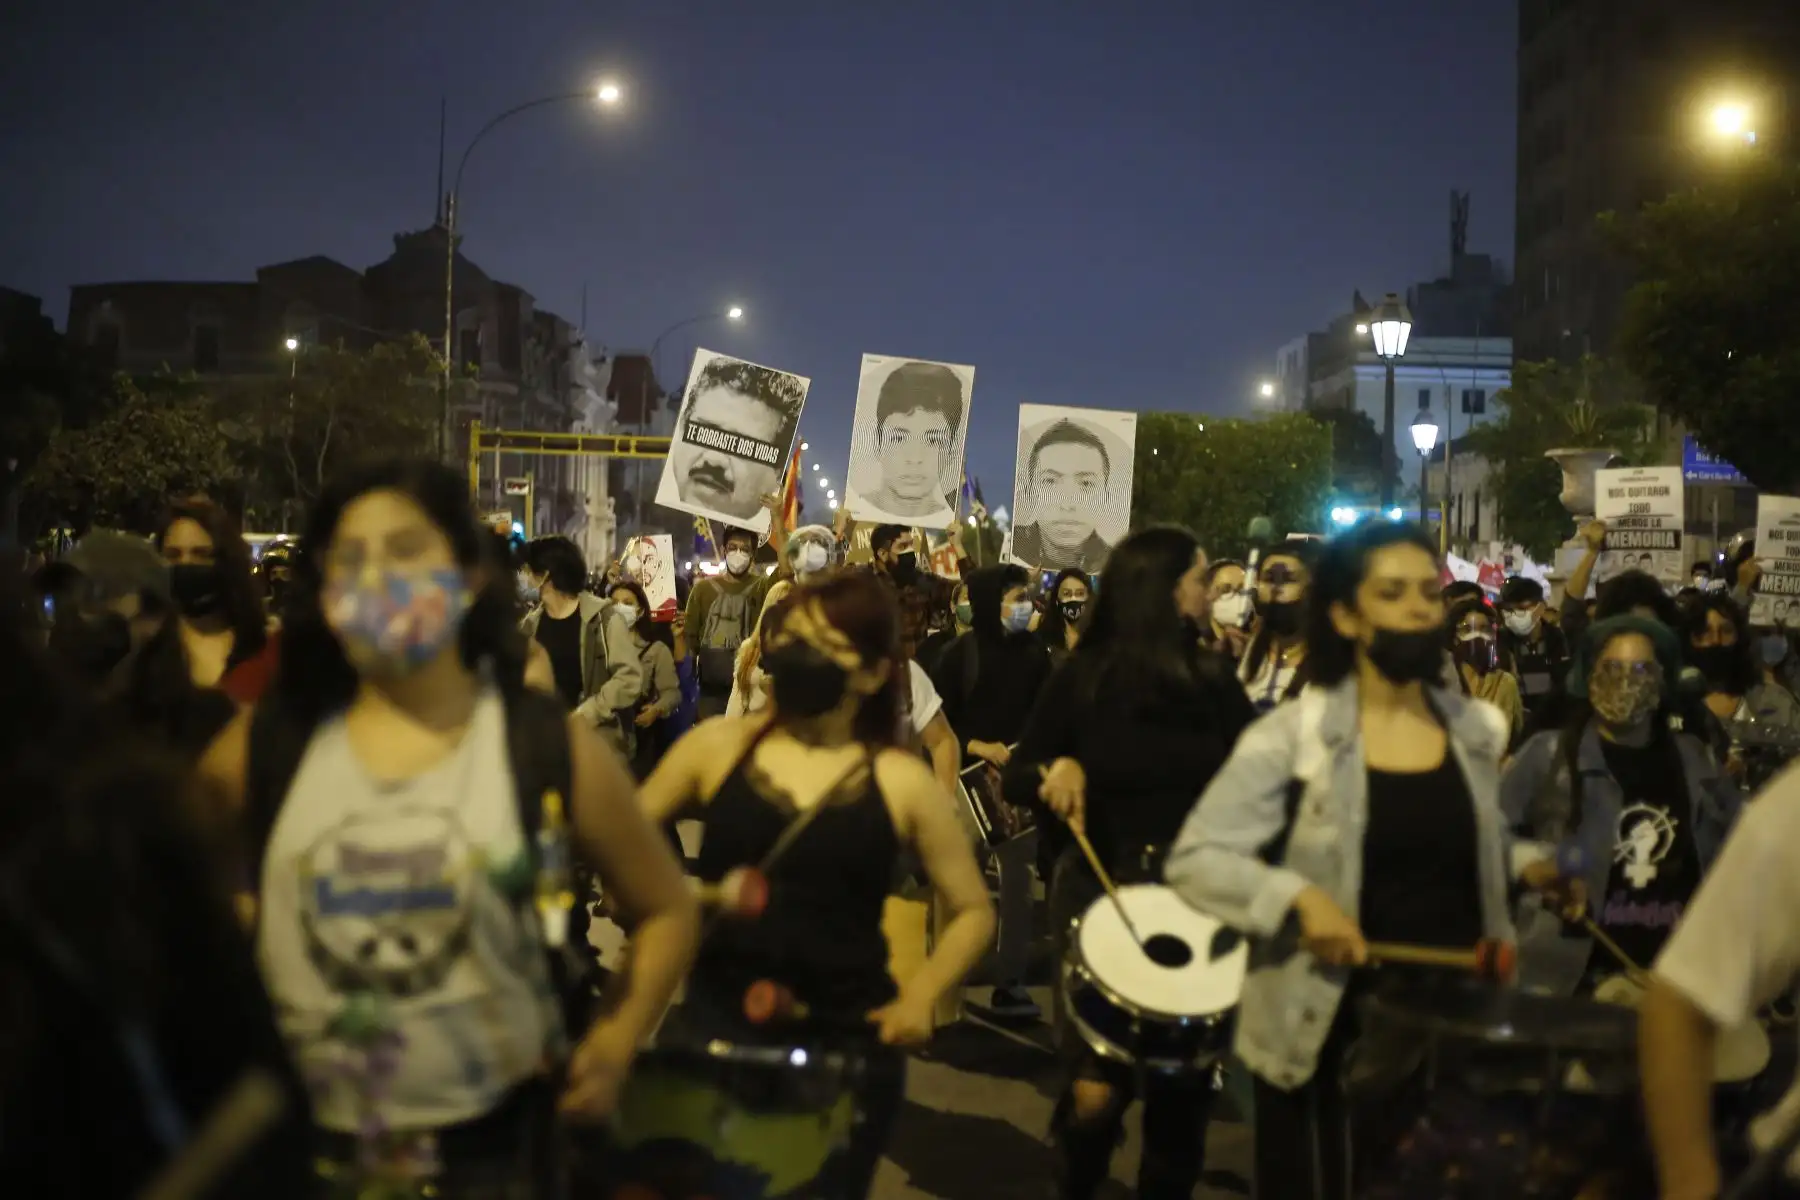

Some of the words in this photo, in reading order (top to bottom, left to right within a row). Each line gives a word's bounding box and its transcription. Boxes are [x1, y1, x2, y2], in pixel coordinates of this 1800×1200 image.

[686, 423, 698, 441] TE
[696, 427, 738, 453] COBRASTE
[737, 438, 754, 457] DOS
[754, 443, 779, 464] VIDAS
[1617, 517, 1649, 528] MENOS
[1651, 517, 1662, 528] LA
[1605, 530, 1675, 548] MEMORIA
